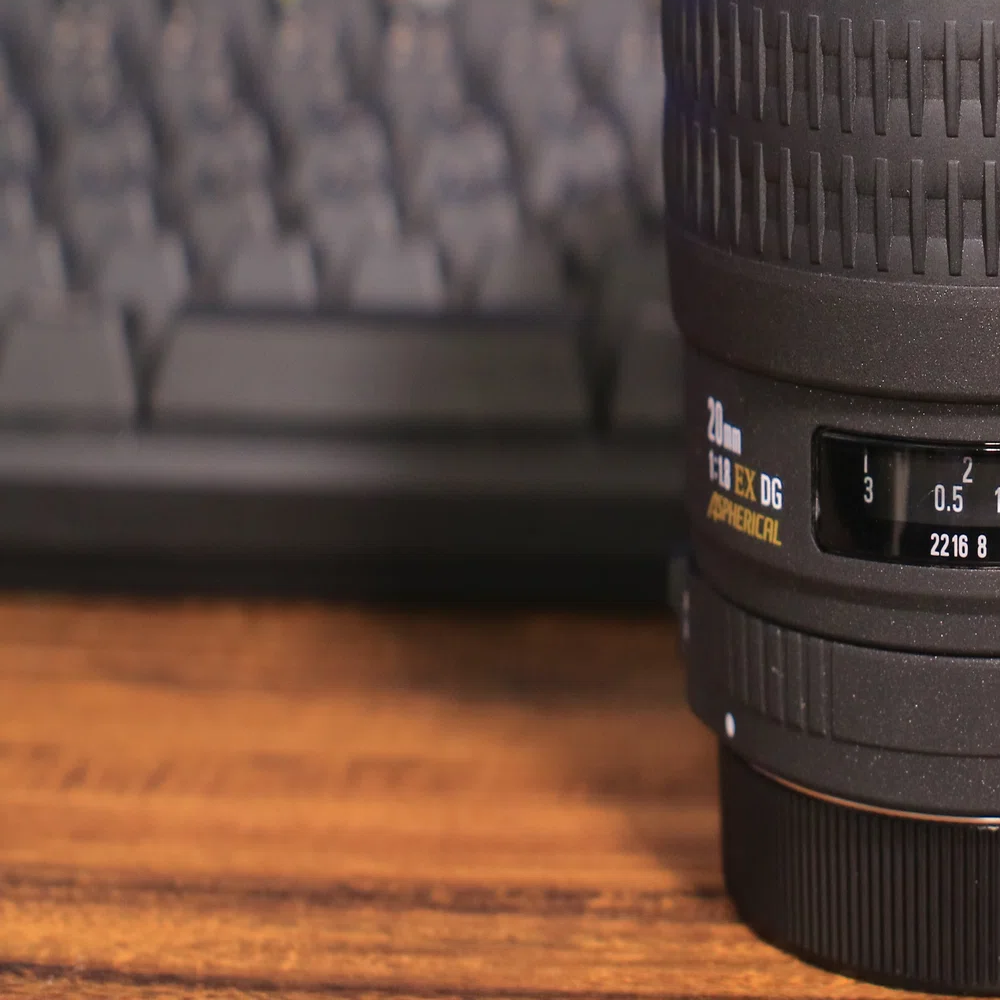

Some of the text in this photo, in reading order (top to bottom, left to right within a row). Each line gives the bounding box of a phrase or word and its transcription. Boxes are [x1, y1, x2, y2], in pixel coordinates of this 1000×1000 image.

[707, 396, 741, 456] 20mm
[734, 462, 757, 502] EX
[760, 473, 783, 510] DG
[962, 456, 974, 484] 2
[934, 484, 964, 513] 0.5
[706, 491, 783, 547] ASPHERICAL
[977, 534, 988, 559] 8
